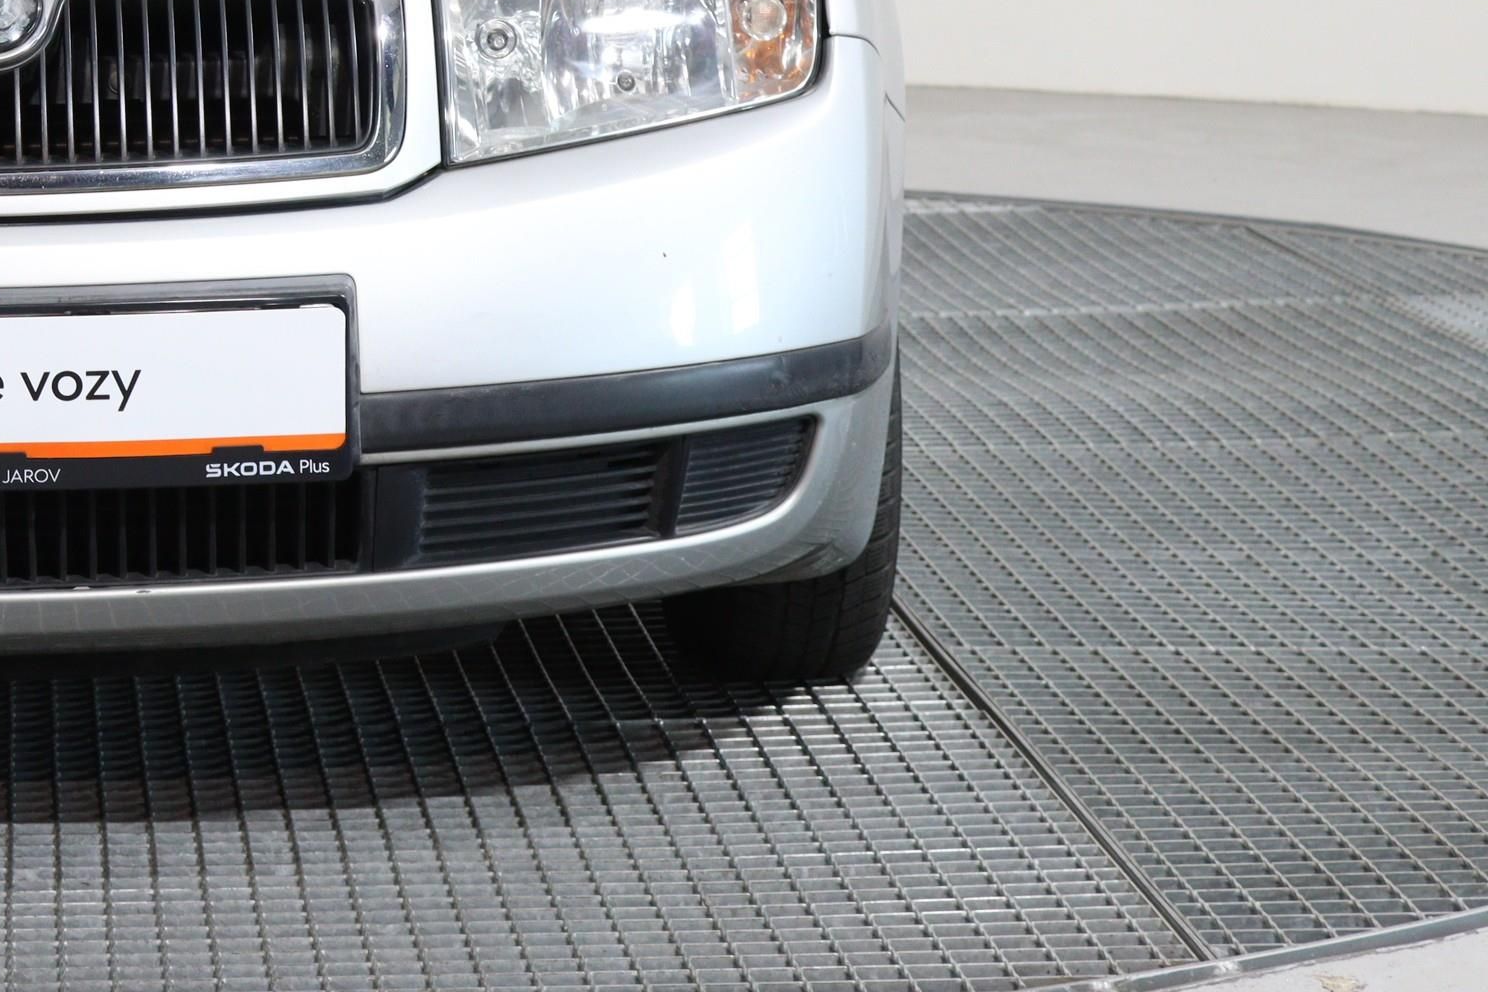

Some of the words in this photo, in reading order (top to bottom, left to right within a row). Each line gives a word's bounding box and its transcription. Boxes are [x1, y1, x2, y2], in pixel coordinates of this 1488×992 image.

[20, 369, 141, 412] vozy
[299, 459, 330, 474] Plus
[2, 468, 61, 484] JAROV
